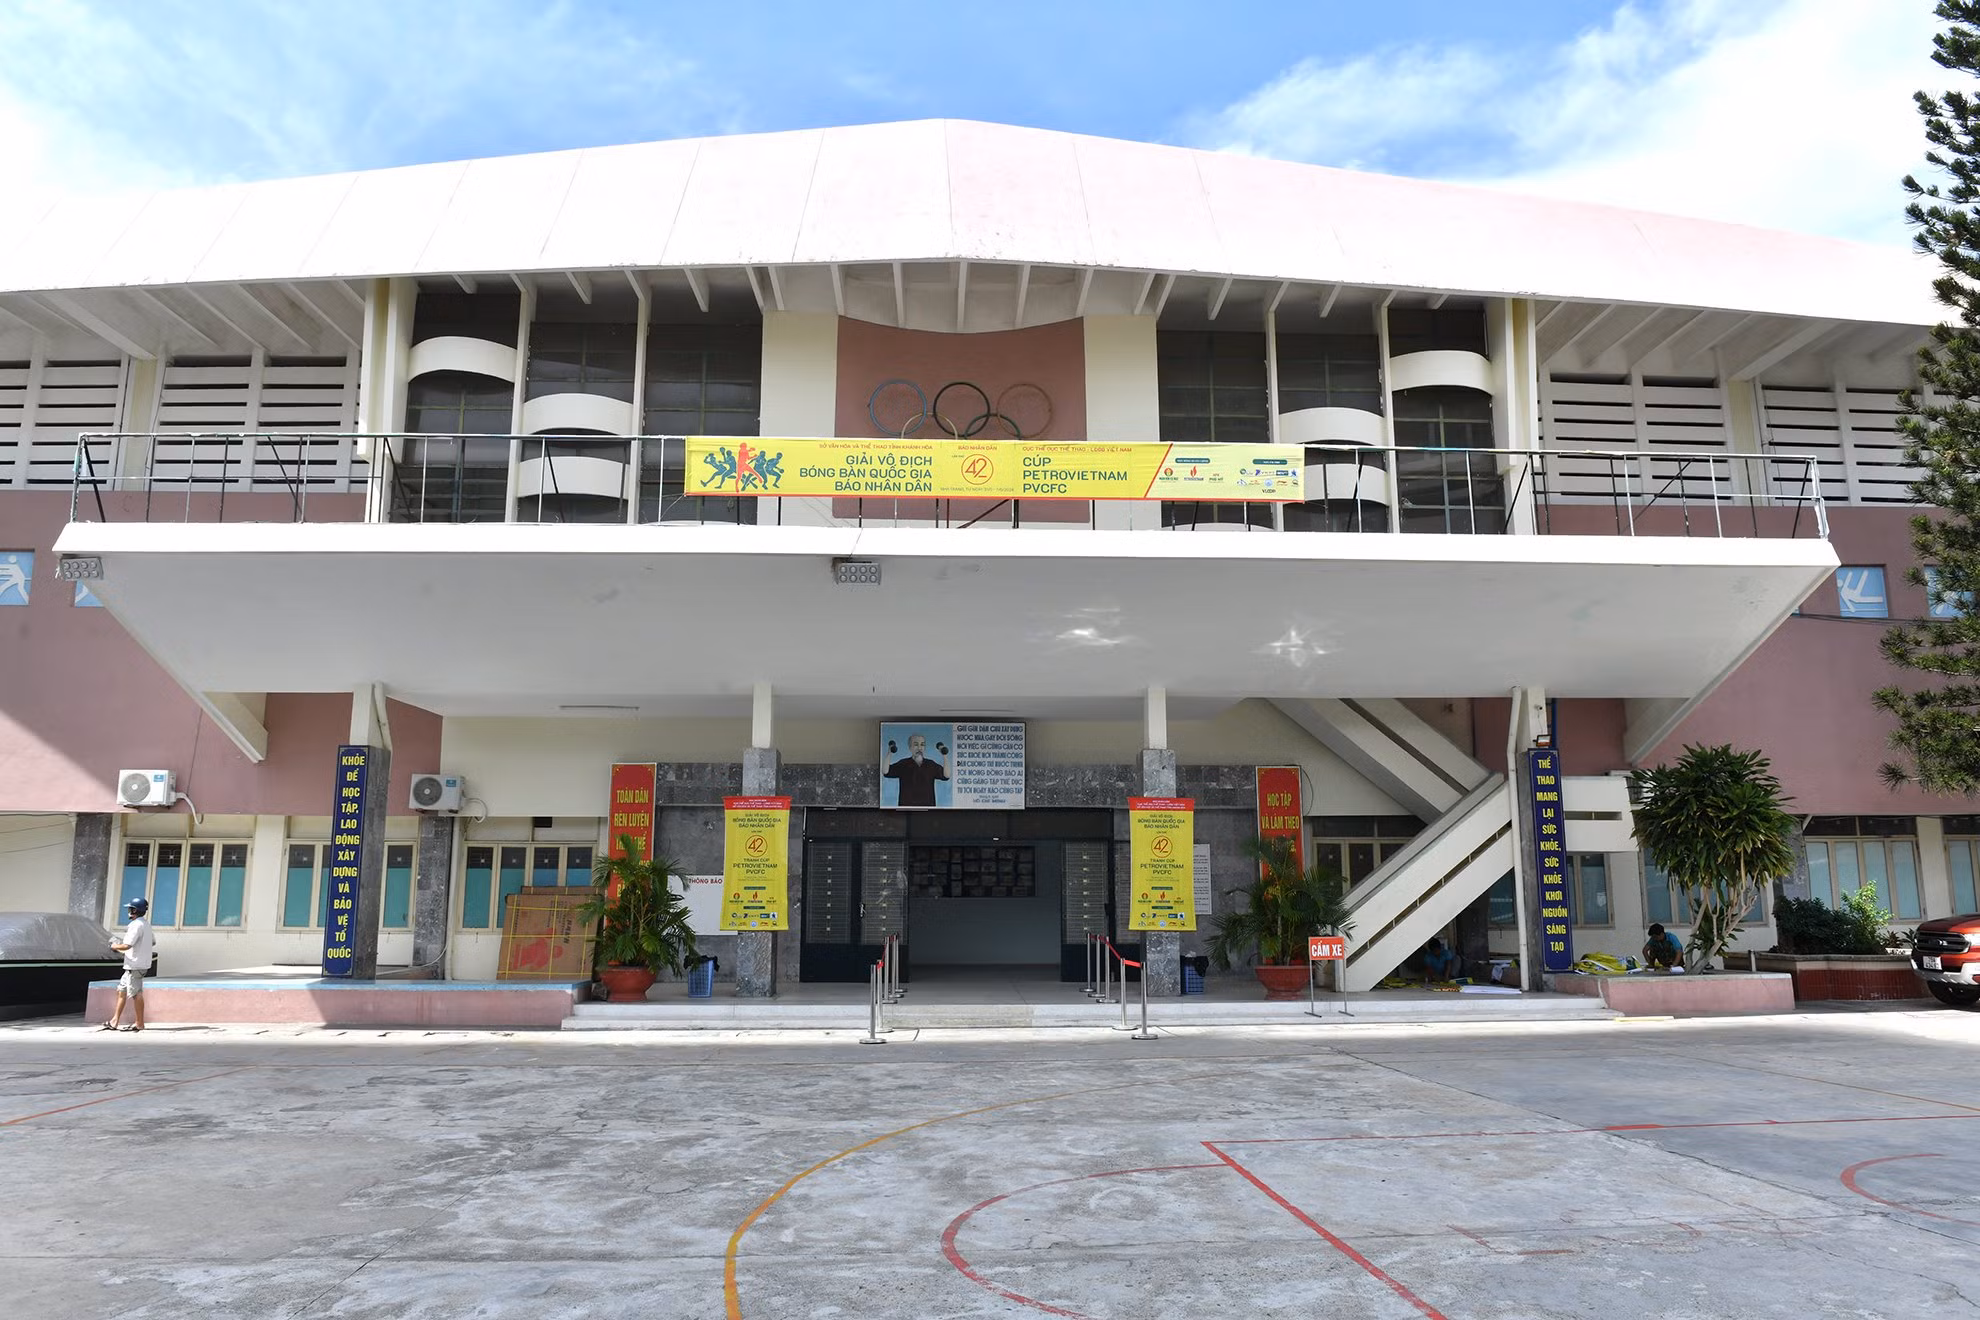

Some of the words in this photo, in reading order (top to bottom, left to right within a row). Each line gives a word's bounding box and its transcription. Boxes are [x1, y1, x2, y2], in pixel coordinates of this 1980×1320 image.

[846, 451, 873, 465] GIẢI
[877, 452, 895, 465] VÔ
[900, 456, 932, 468] ĐỊCH
[1023, 454, 1051, 467] CÚP
[799, 464, 836, 478] BÓNG
[839, 465, 866, 478] BÀN
[869, 464, 907, 479] QUỐC
[910, 469, 932, 479] GIA
[965, 457, 987, 478] 42
[1023, 470, 1128, 480] PETROVIETNAM
[835, 478, 861, 491] BÁO
[864, 478, 901, 491] NHÂN
[905, 479, 932, 492] DÂN
[1023, 483, 1067, 493] PVCFC
[342, 753, 365, 766] KHỎE
[1537, 756, 1551, 768] THỂ
[1536, 775, 1555, 785] THAO
[342, 787, 360, 799] HỌC
[1536, 792, 1558, 801] MANG
[1542, 808, 1554, 820] LẠI
[340, 819, 357, 829] LAO
[1542, 823, 1557, 834] SỨC
[335, 833, 360, 847] ĐỘNG
[748, 837, 764, 853] 42
[1153, 838, 1169, 853] 42
[337, 849, 356, 860] XÂY
[1544, 856, 1559, 868] SỨC
[333, 866, 357, 879] DỰNG
[338, 881, 350, 893] VÀ
[333, 896, 352, 909] BẢO
[337, 913, 348, 927] VỆ
[1546, 923, 1566, 934] SÁNG
[327, 944, 352, 959] QUỐC
[1311, 940, 1330, 957] CẤM
[1332, 944, 1343, 957] XE
[1550, 941, 1564, 953] TẠO
